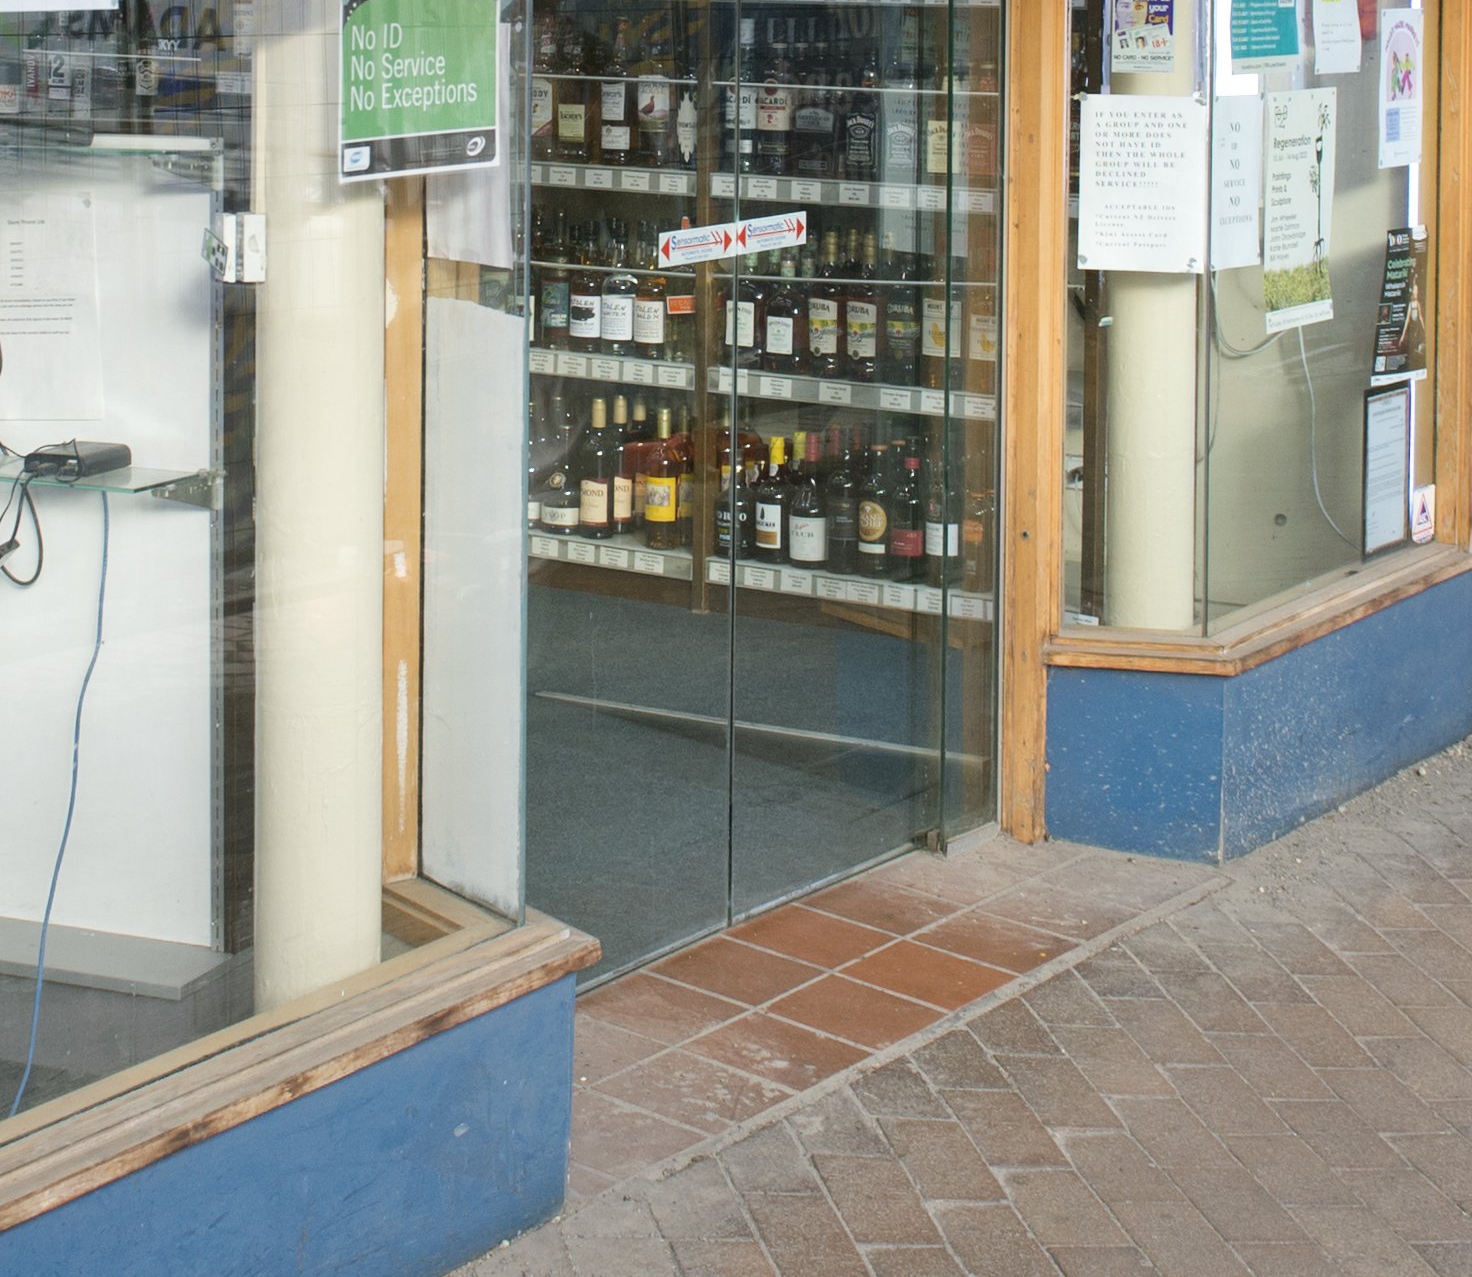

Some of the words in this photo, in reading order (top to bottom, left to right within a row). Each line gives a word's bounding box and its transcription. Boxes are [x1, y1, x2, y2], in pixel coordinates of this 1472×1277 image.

[1148, 4, 1169, 14] your
[1148, 13, 1169, 24] Card
[351, 24, 376, 51] No
[383, 22, 403, 49] ID
[350, 54, 376, 81] No
[381, 51, 446, 79] Service
[350, 85, 375, 112] No
[381, 79, 477, 112] Exceptions
[1105, 121, 1140, 129] GROUP
[1229, 122, 1241, 133] NO
[1273, 135, 1312, 151] Regeneration
[1150, 151, 1186, 159] WHOLE
[1229, 158, 1240, 170] NO
[1229, 195, 1240, 207] NO
